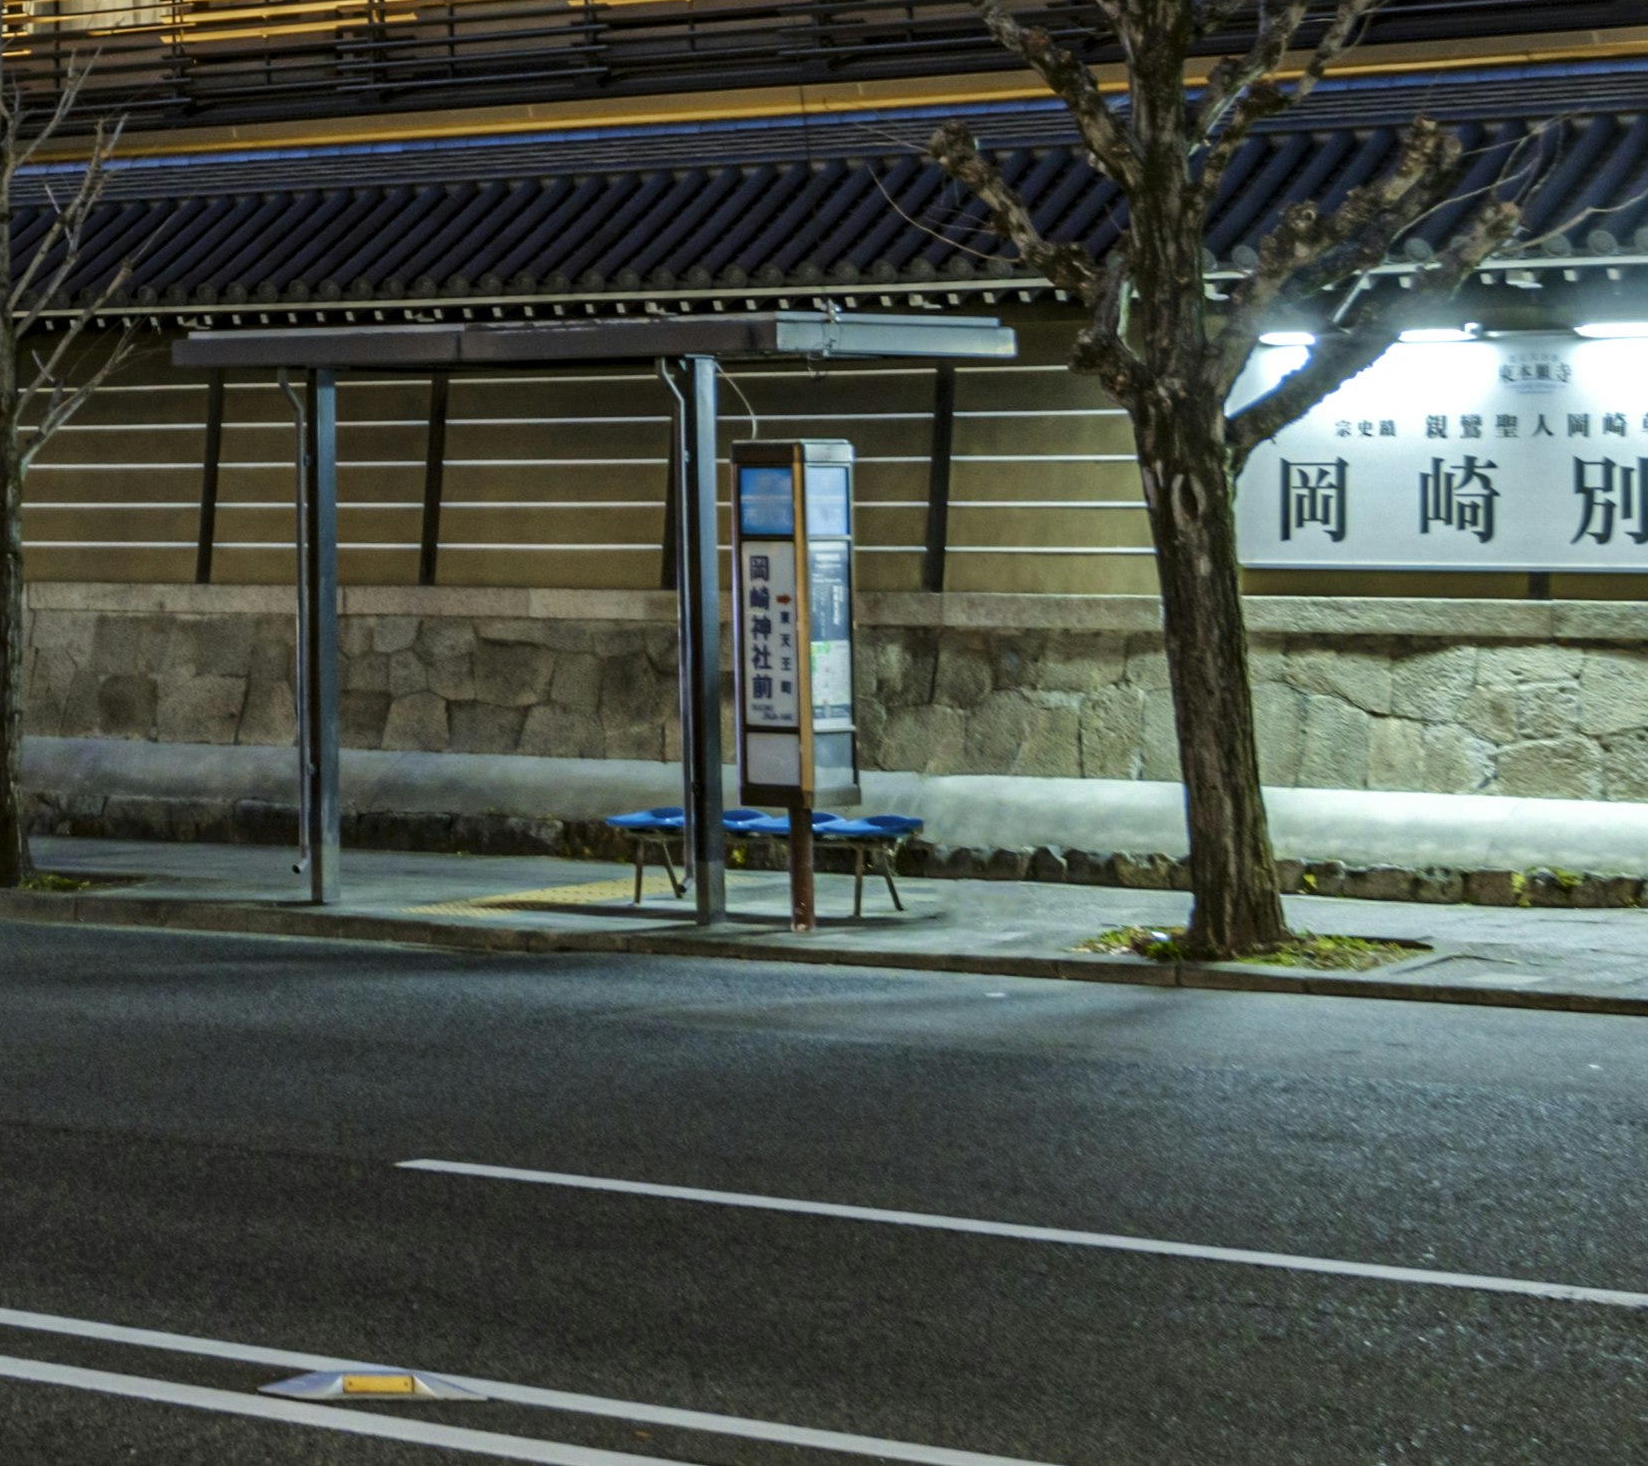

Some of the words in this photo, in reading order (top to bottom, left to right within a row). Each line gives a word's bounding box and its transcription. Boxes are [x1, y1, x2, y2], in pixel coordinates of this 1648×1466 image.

[749, 555, 773, 699] 岡崎神社前
